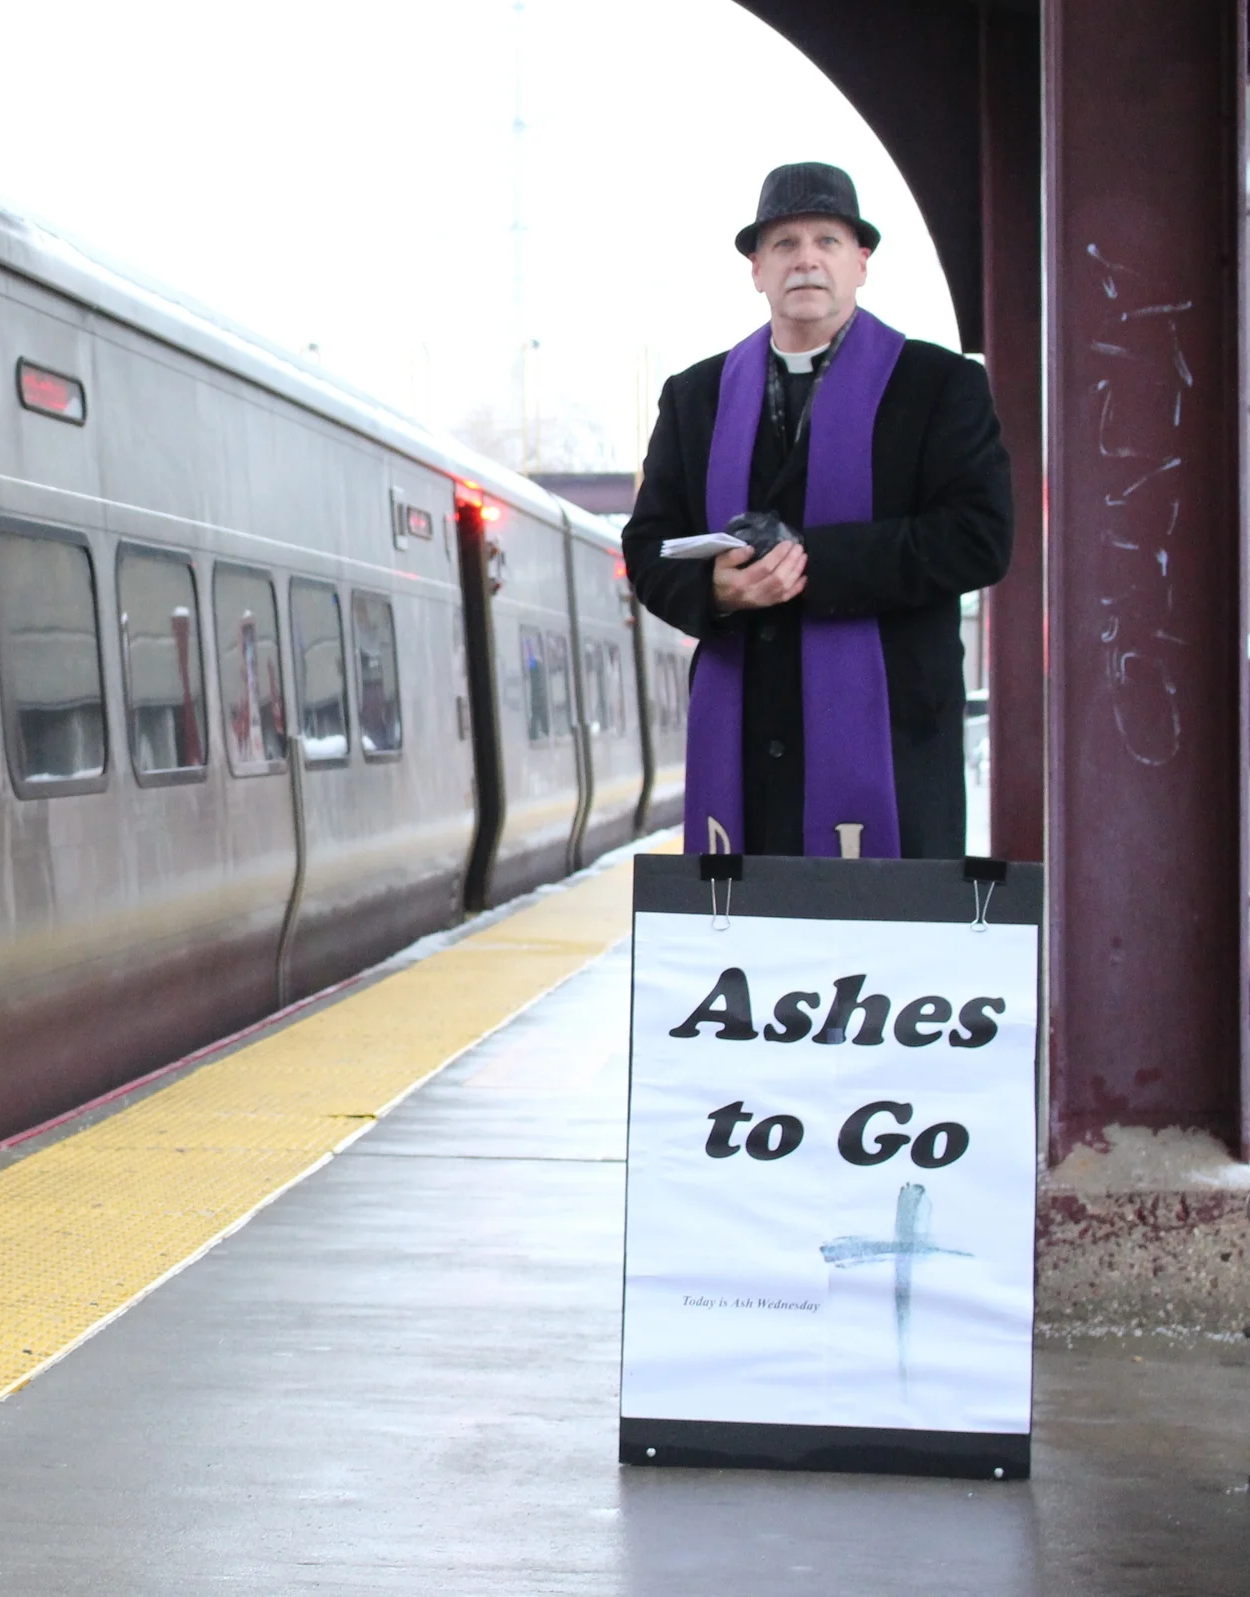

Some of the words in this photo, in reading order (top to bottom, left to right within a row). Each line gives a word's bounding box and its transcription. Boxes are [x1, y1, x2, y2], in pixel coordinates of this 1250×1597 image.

[668, 967, 1006, 1049] Ashes
[705, 1101, 804, 1161] to
[838, 1101, 970, 1169] Go
[683, 1295, 716, 1309] Today
[719, 1297, 728, 1307] is
[731, 1297, 754, 1309] Ash
[757, 1298, 821, 1313] Wednesday
